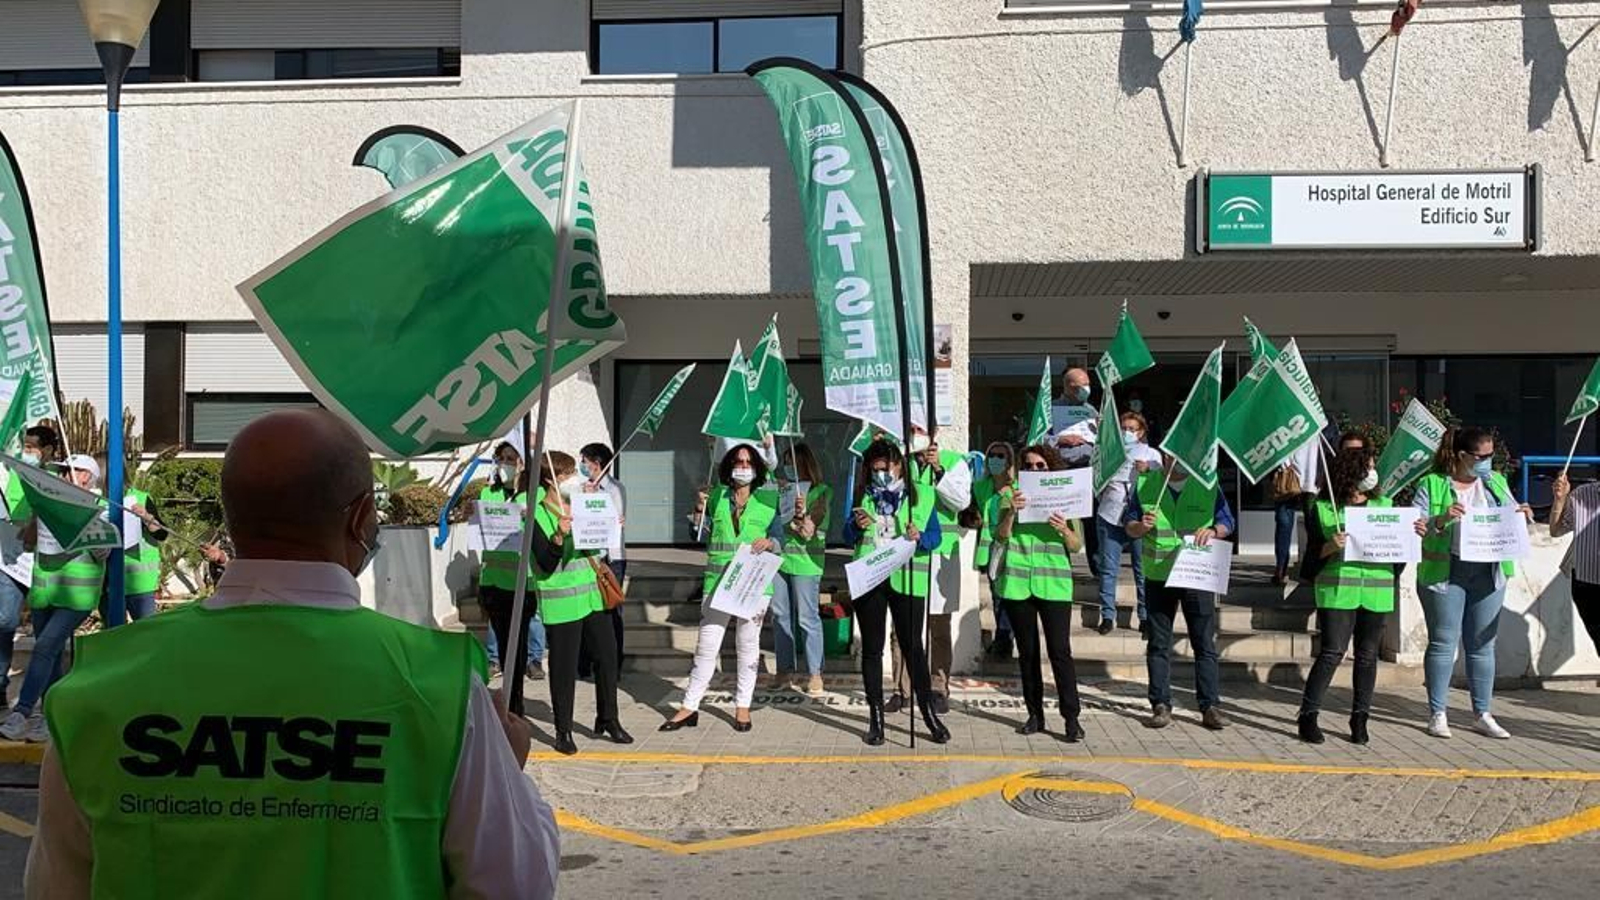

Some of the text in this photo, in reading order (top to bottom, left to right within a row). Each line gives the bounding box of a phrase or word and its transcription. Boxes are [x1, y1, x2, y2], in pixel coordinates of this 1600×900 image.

[1308, 182, 1512, 205] Hospital General de Motril
[1421, 207, 1511, 224] Edificio Sur
[1039, 476, 1073, 486] SATSE
[1366, 514, 1400, 524] SATSE
[119, 714, 391, 783] SATSE
[119, 793, 379, 822] Sindicato de Enfermería
